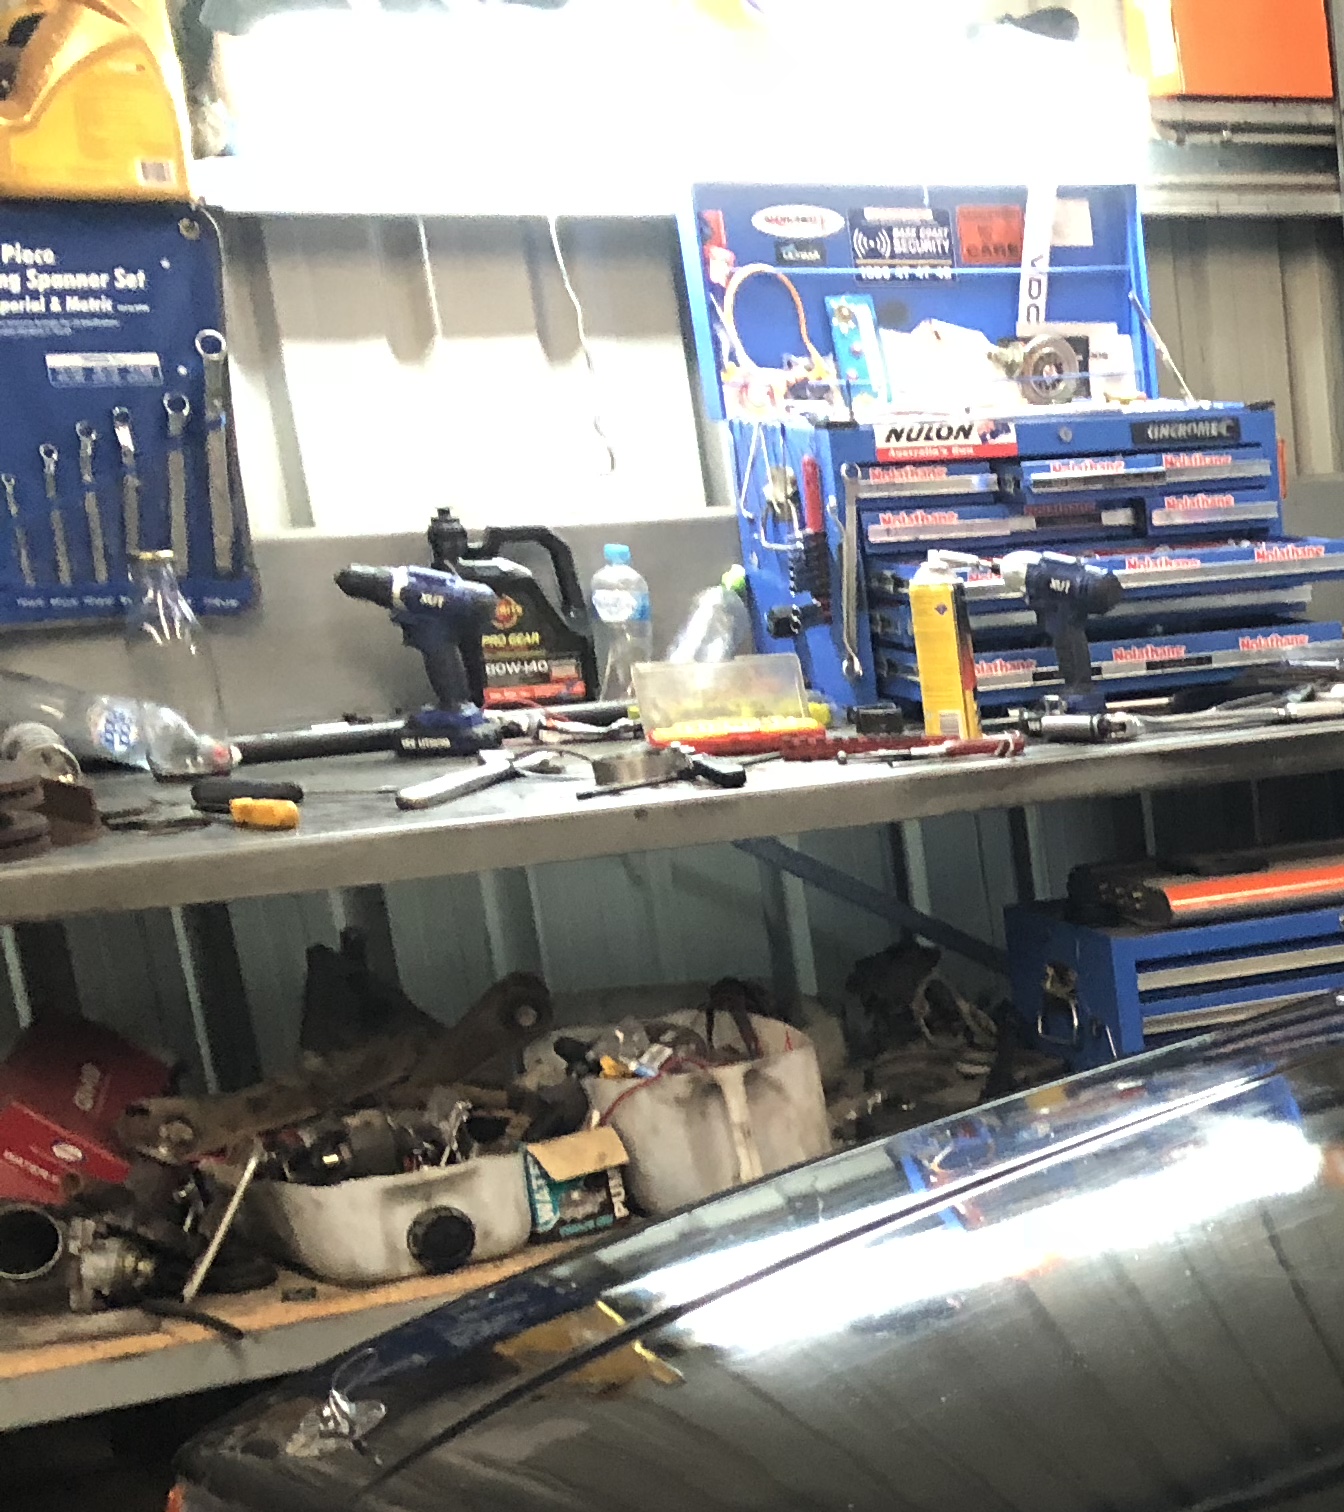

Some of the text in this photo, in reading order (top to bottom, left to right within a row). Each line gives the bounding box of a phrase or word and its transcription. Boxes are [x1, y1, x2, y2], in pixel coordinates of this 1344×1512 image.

[0, 266, 146, 293] ng Spanner Set
[0, 296, 45, 315] perial
[885, 423, 974, 443] NULON
[482, 633, 507, 648] PRO
[975, 658, 1037, 677] olathane
